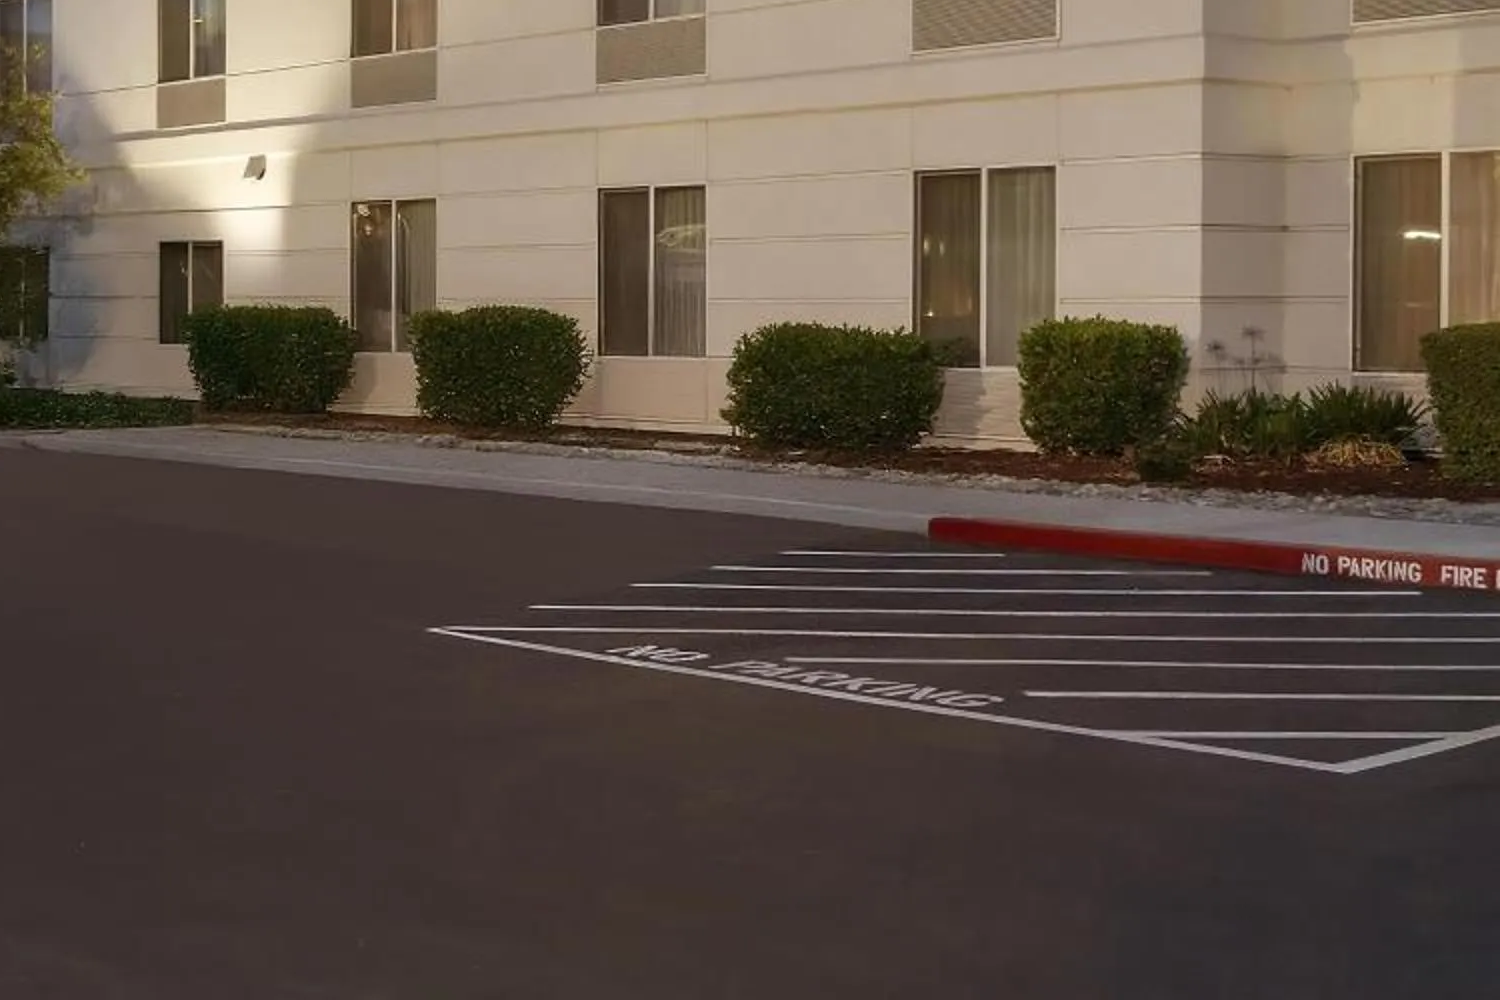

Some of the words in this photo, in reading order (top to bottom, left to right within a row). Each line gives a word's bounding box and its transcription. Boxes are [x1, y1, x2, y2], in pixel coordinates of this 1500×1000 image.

[1301, 553, 1329, 574] NO
[1337, 556, 1422, 583] PARKING
[1440, 565, 1487, 589] FIRE
[606, 645, 709, 661] NO
[710, 660, 1004, 707] PARKING
